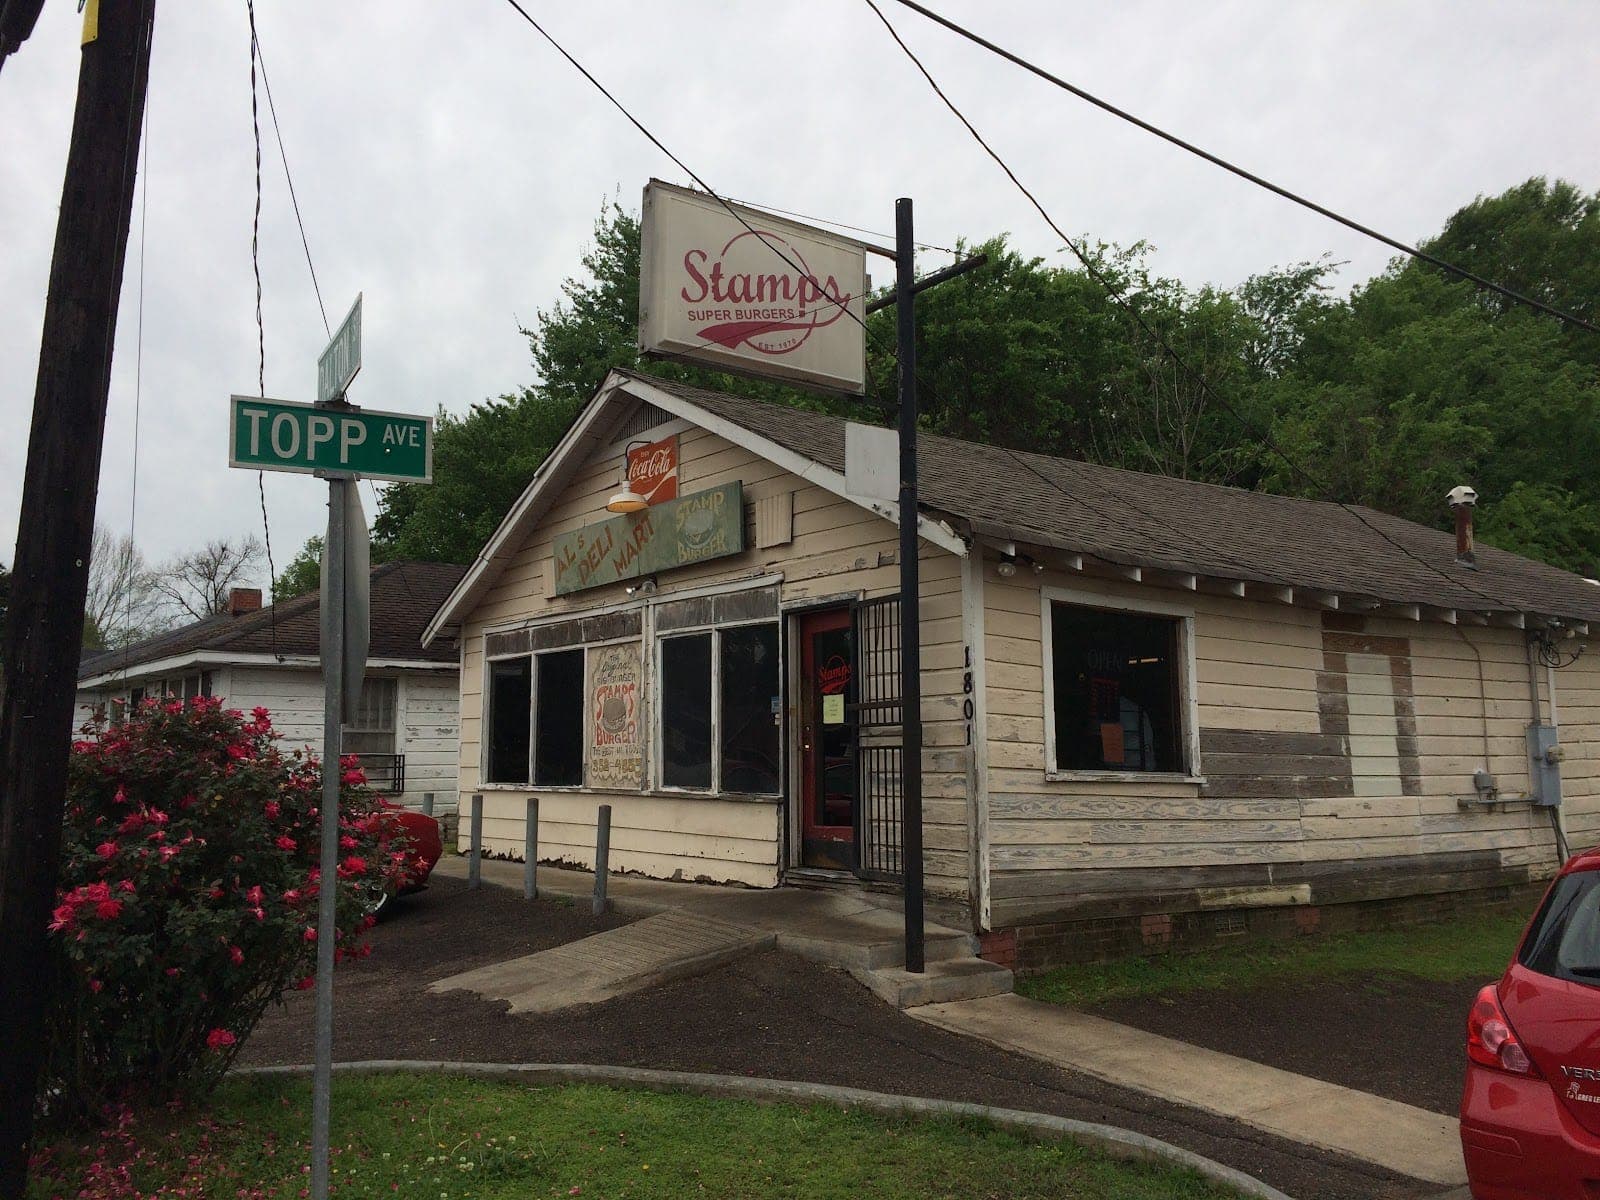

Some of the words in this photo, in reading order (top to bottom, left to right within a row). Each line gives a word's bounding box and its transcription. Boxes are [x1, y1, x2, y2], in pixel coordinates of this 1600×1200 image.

[681, 249, 850, 318] Stamps
[688, 309, 732, 321] SUPER
[735, 308, 795, 320] BURGERS
[243, 408, 368, 464] TOPP
[382, 423, 421, 447] AVE
[579, 525, 613, 585] DELI
[613, 514, 655, 577] MART
[596, 683, 635, 721] STAMPS
[962, 645, 974, 747] 1801
[596, 720, 636, 746] BURGER
